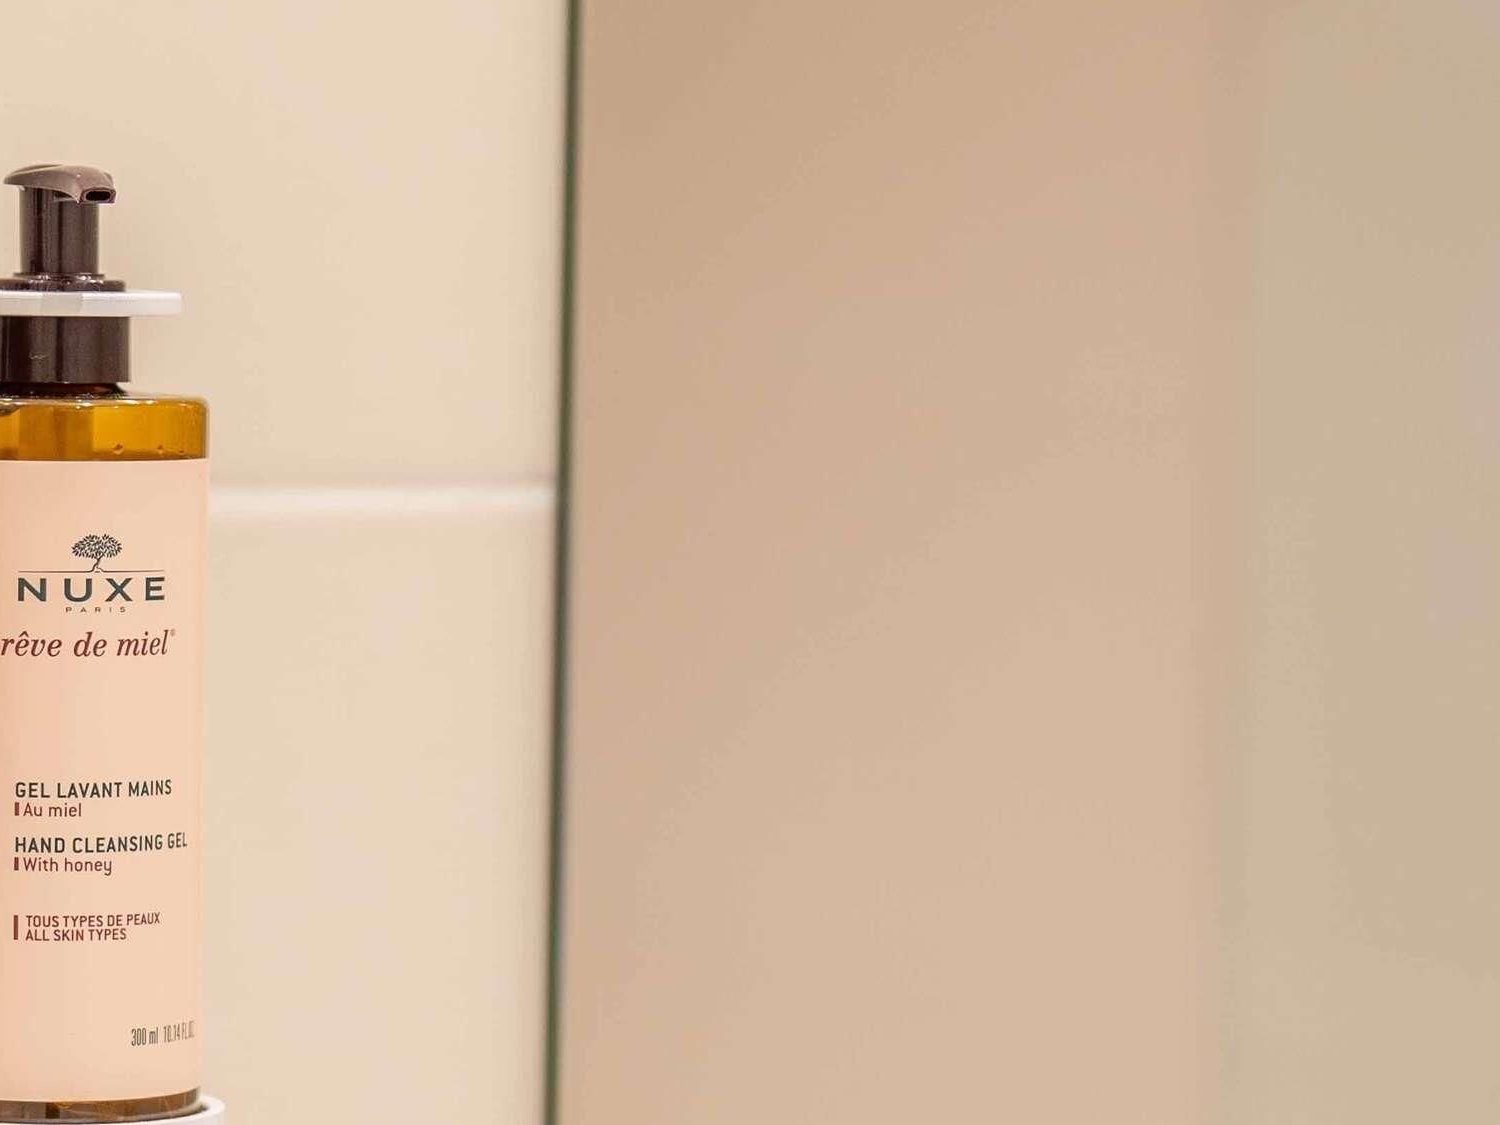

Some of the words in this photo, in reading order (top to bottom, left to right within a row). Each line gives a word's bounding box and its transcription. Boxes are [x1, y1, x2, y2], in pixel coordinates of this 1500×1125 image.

[17, 576, 165, 602] NUXE
[0, 631, 62, 657] rêve
[73, 632, 107, 657] de
[15, 782, 50, 798] GEL
[57, 782, 122, 798] LAVANT
[128, 779, 172, 797] MAINS
[23, 803, 42, 816] Au
[49, 802, 82, 817] miel
[15, 837, 65, 853] HAND
[72, 834, 163, 853] CLEANSING
[168, 832, 188, 849] GEL
[23, 857, 58, 872] With
[64, 858, 112, 876] honey
[26, 915, 59, 928] TOUS
[63, 915, 103, 928] TYPES
[107, 915, 123, 927] DE
[126, 912, 160, 926] PEAUX
[25, 930, 49, 941] ALL
[53, 929, 84, 941] SKIN
[88, 928, 127, 941] TYPES
[131, 1028, 147, 1046] 300
[149, 1027, 159, 1044] ml
